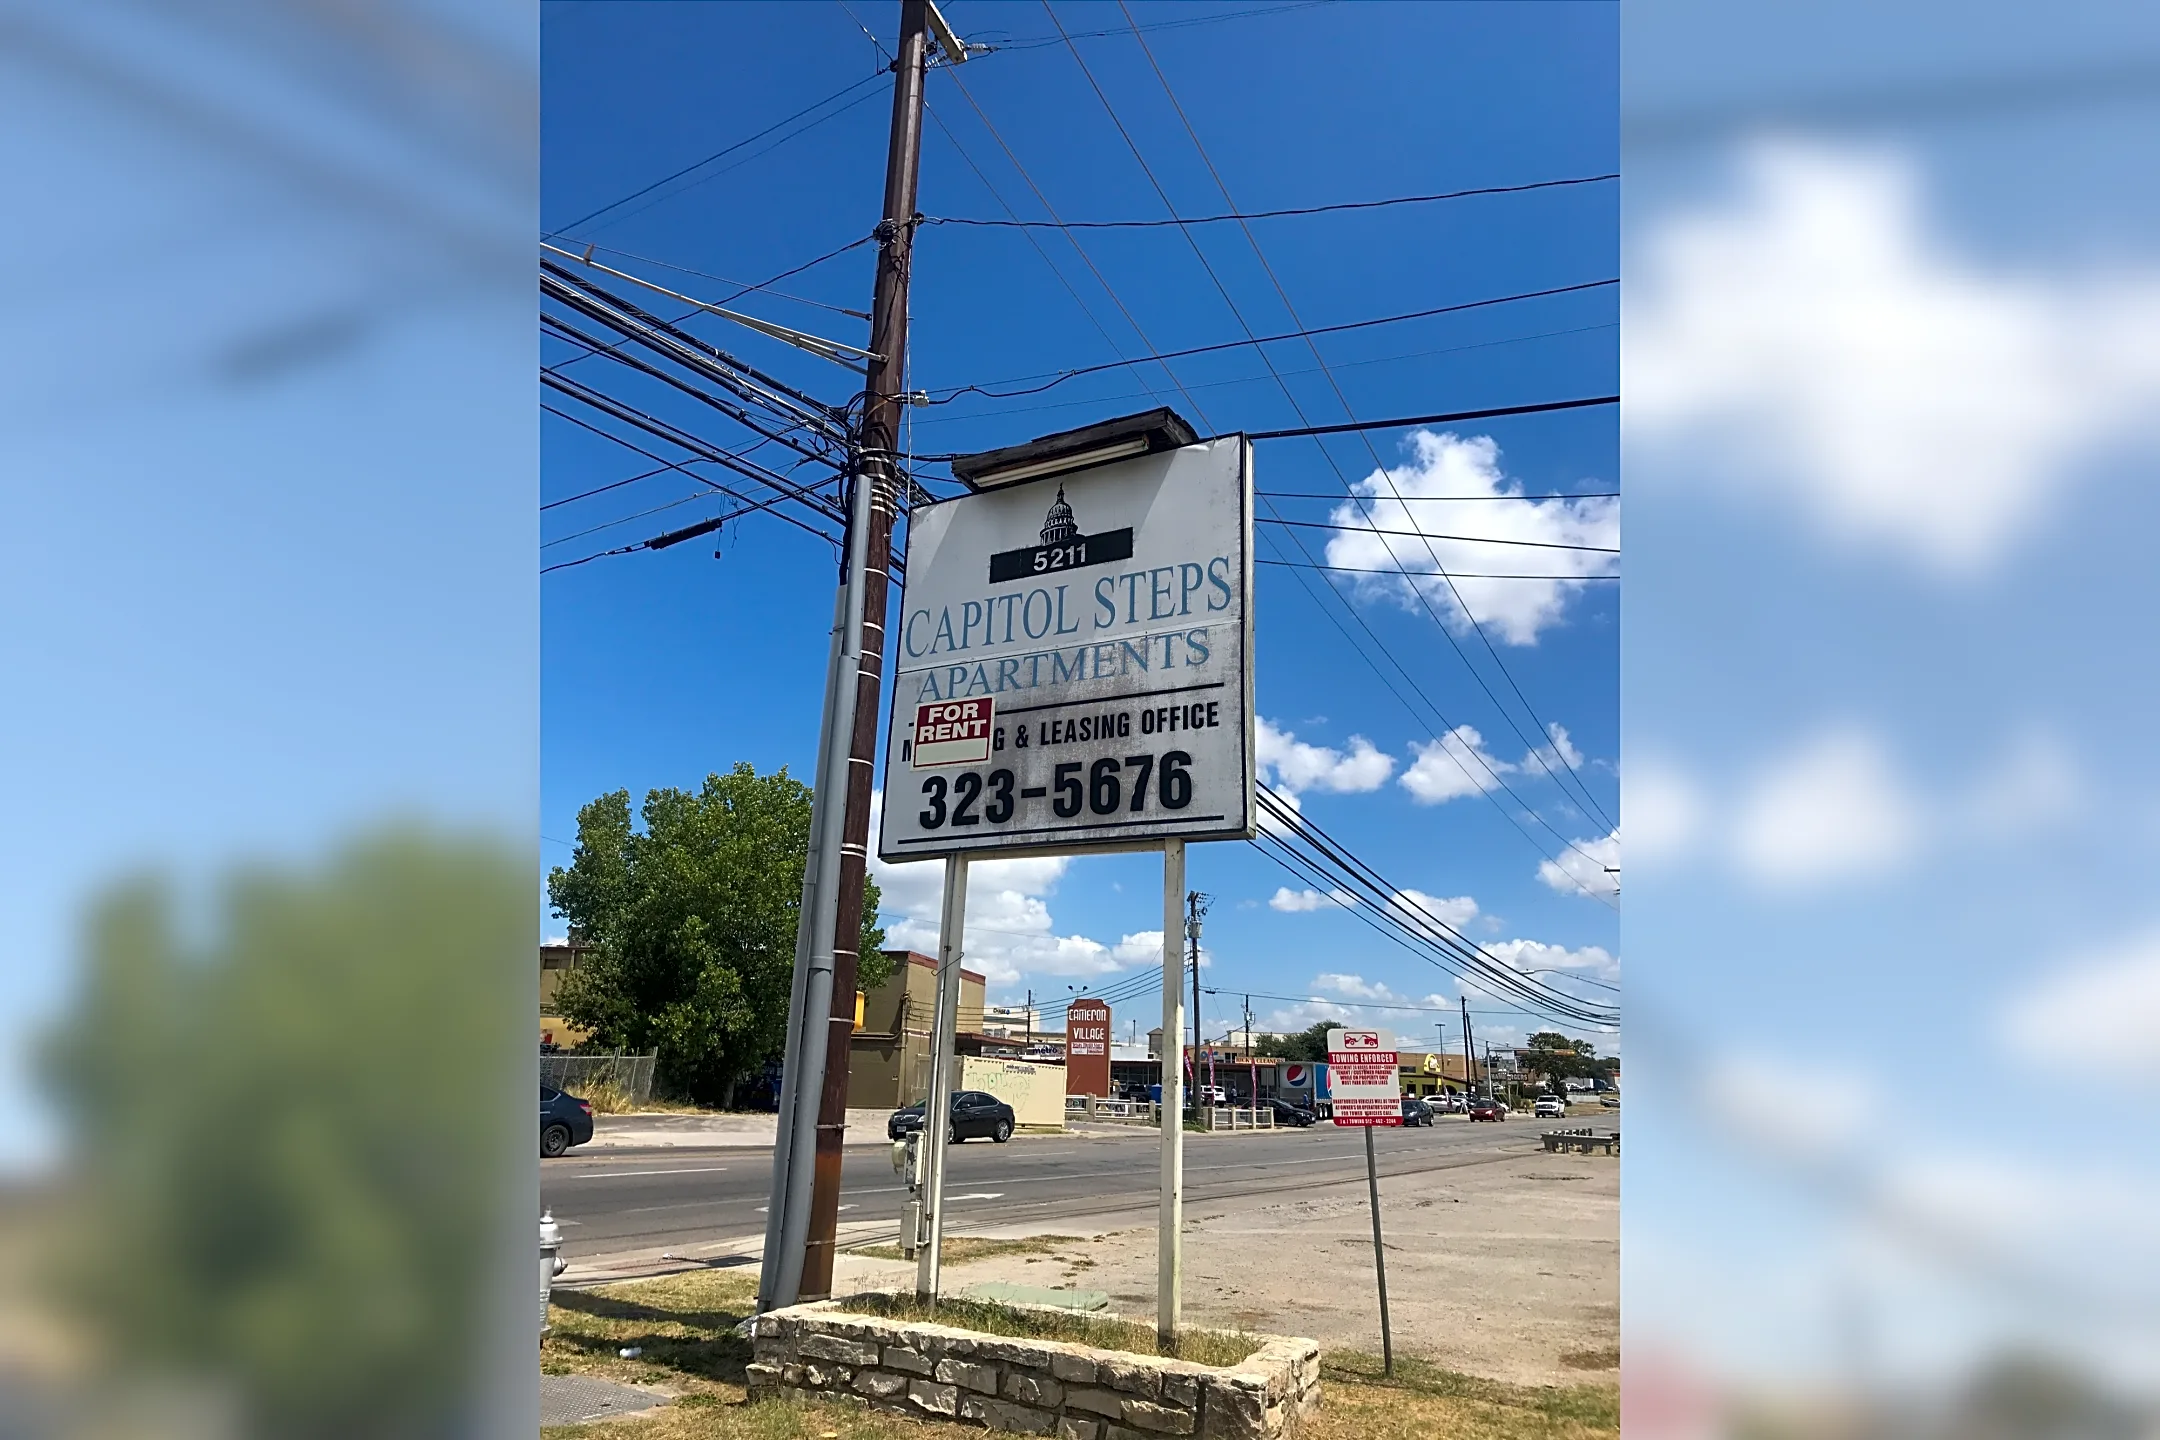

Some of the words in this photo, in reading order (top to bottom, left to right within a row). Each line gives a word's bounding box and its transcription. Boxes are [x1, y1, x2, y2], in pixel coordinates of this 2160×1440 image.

[1033, 543, 1086, 571] 5211
[905, 585, 1080, 658] CAPITOL
[1094, 556, 1231, 629] STEPS
[915, 628, 1209, 703] APARTMENTS
[928, 703, 979, 723] FOR
[919, 719, 987, 742] RENT
[1015, 725, 1029, 748] &
[1040, 712, 1130, 746] LEASING
[1141, 702, 1219, 734] OFFICE
[920, 751, 1192, 829] 323-5676
[1068, 1009, 1107, 1021] CAMERON
[1073, 1028, 1104, 1040] VILLAGE
[1032, 1045, 1058, 1054] metro
[1332, 1054, 1358, 1063] TOWING
[1360, 1054, 1393, 1063] ENFORCED
